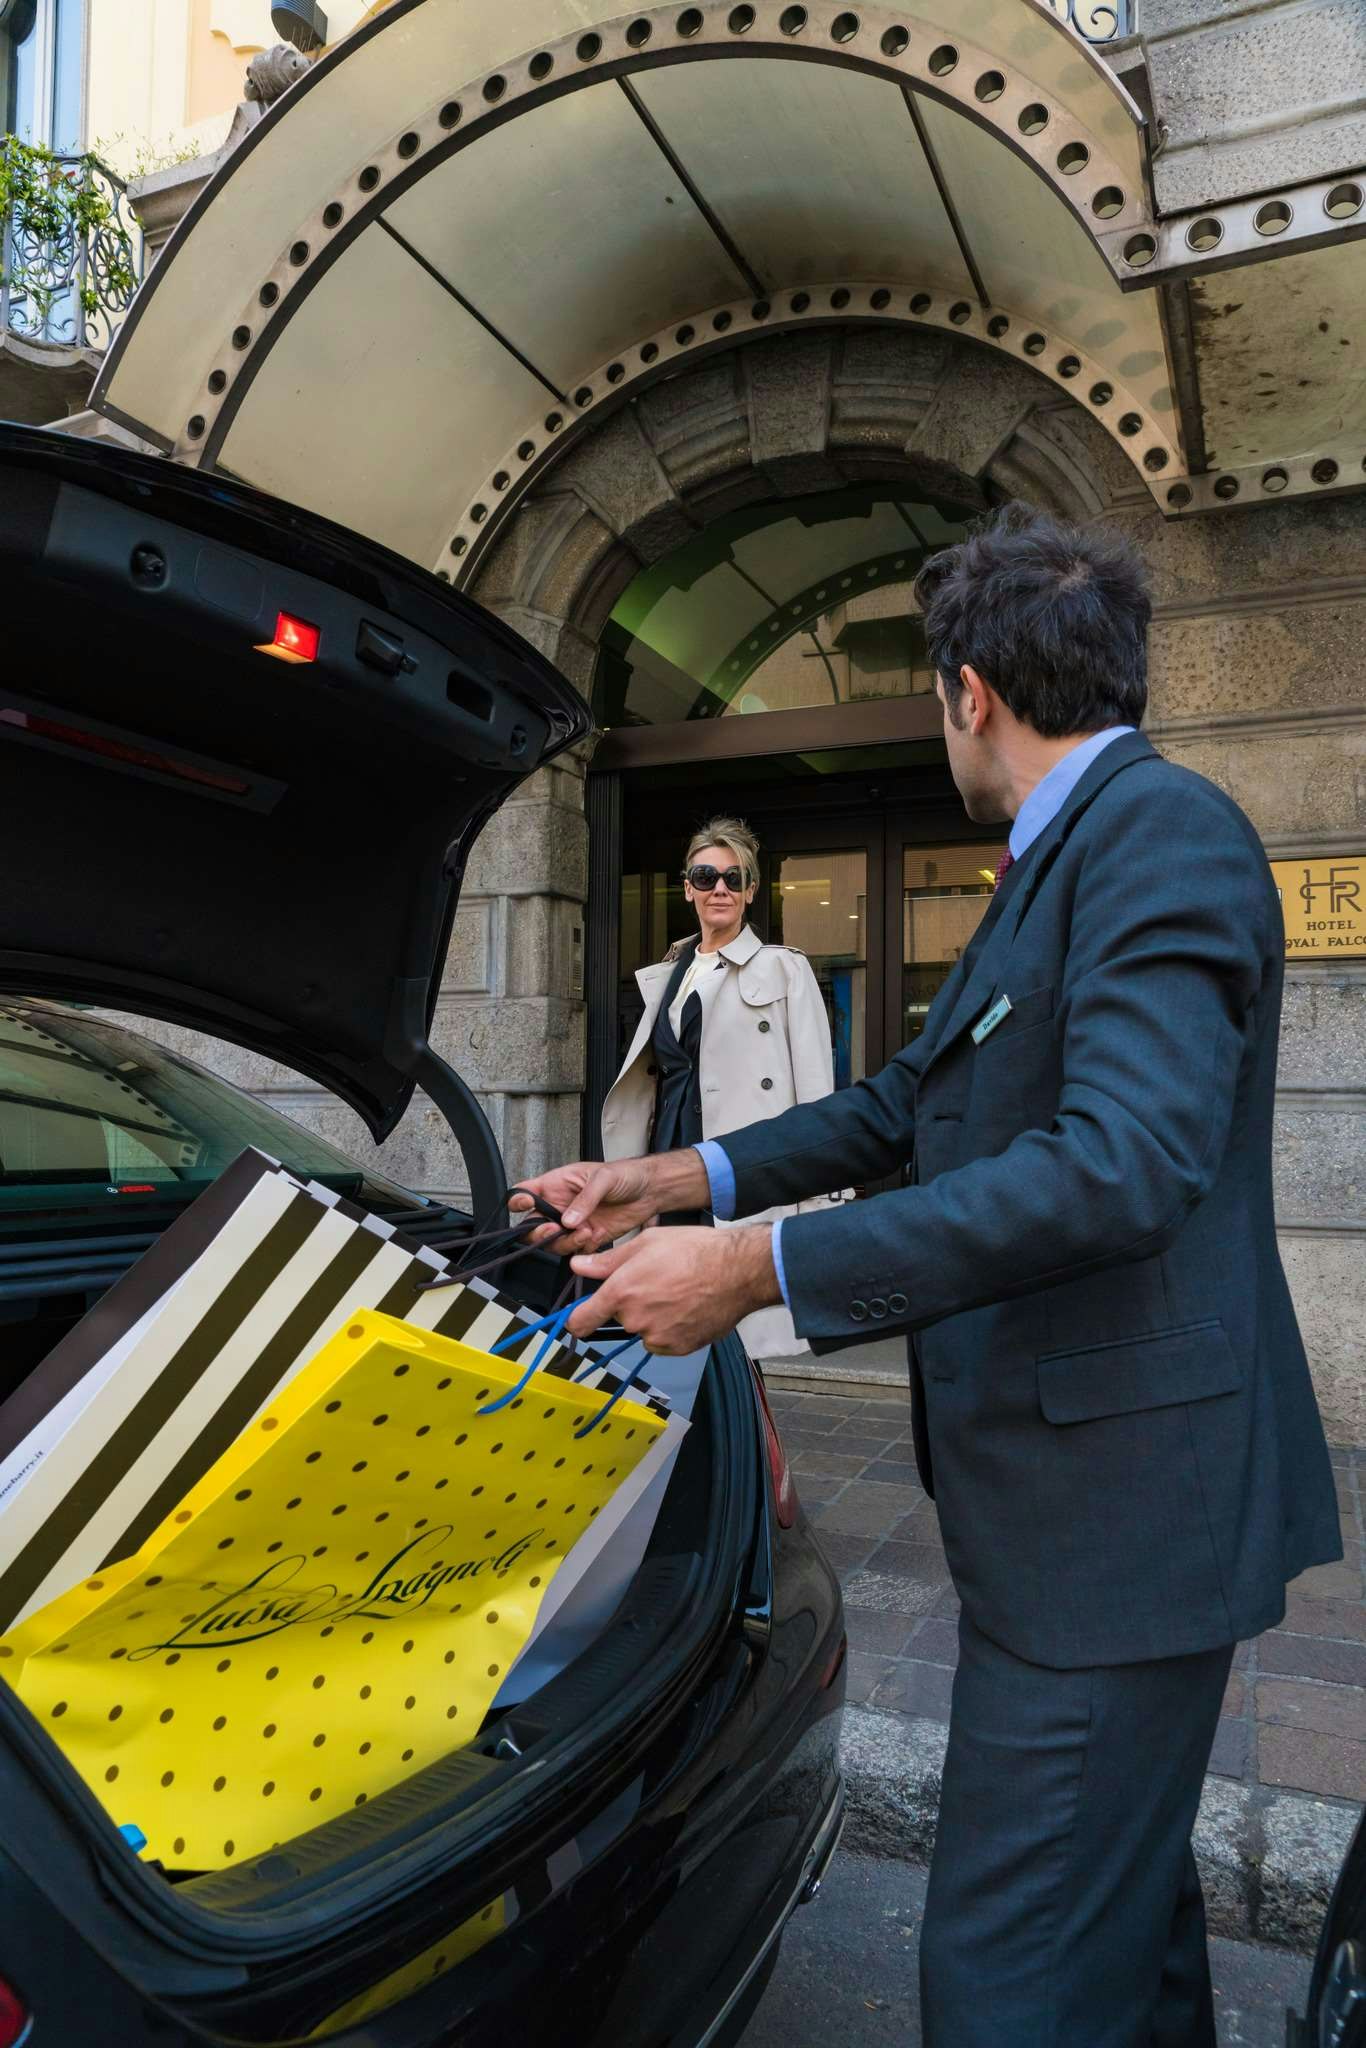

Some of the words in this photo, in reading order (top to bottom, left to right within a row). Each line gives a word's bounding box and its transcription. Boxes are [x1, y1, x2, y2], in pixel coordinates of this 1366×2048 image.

[1307, 920, 1356, 931] HOTEL
[1284, 938, 1320, 949] OYAL
[127, 1554, 337, 1662] Luisa
